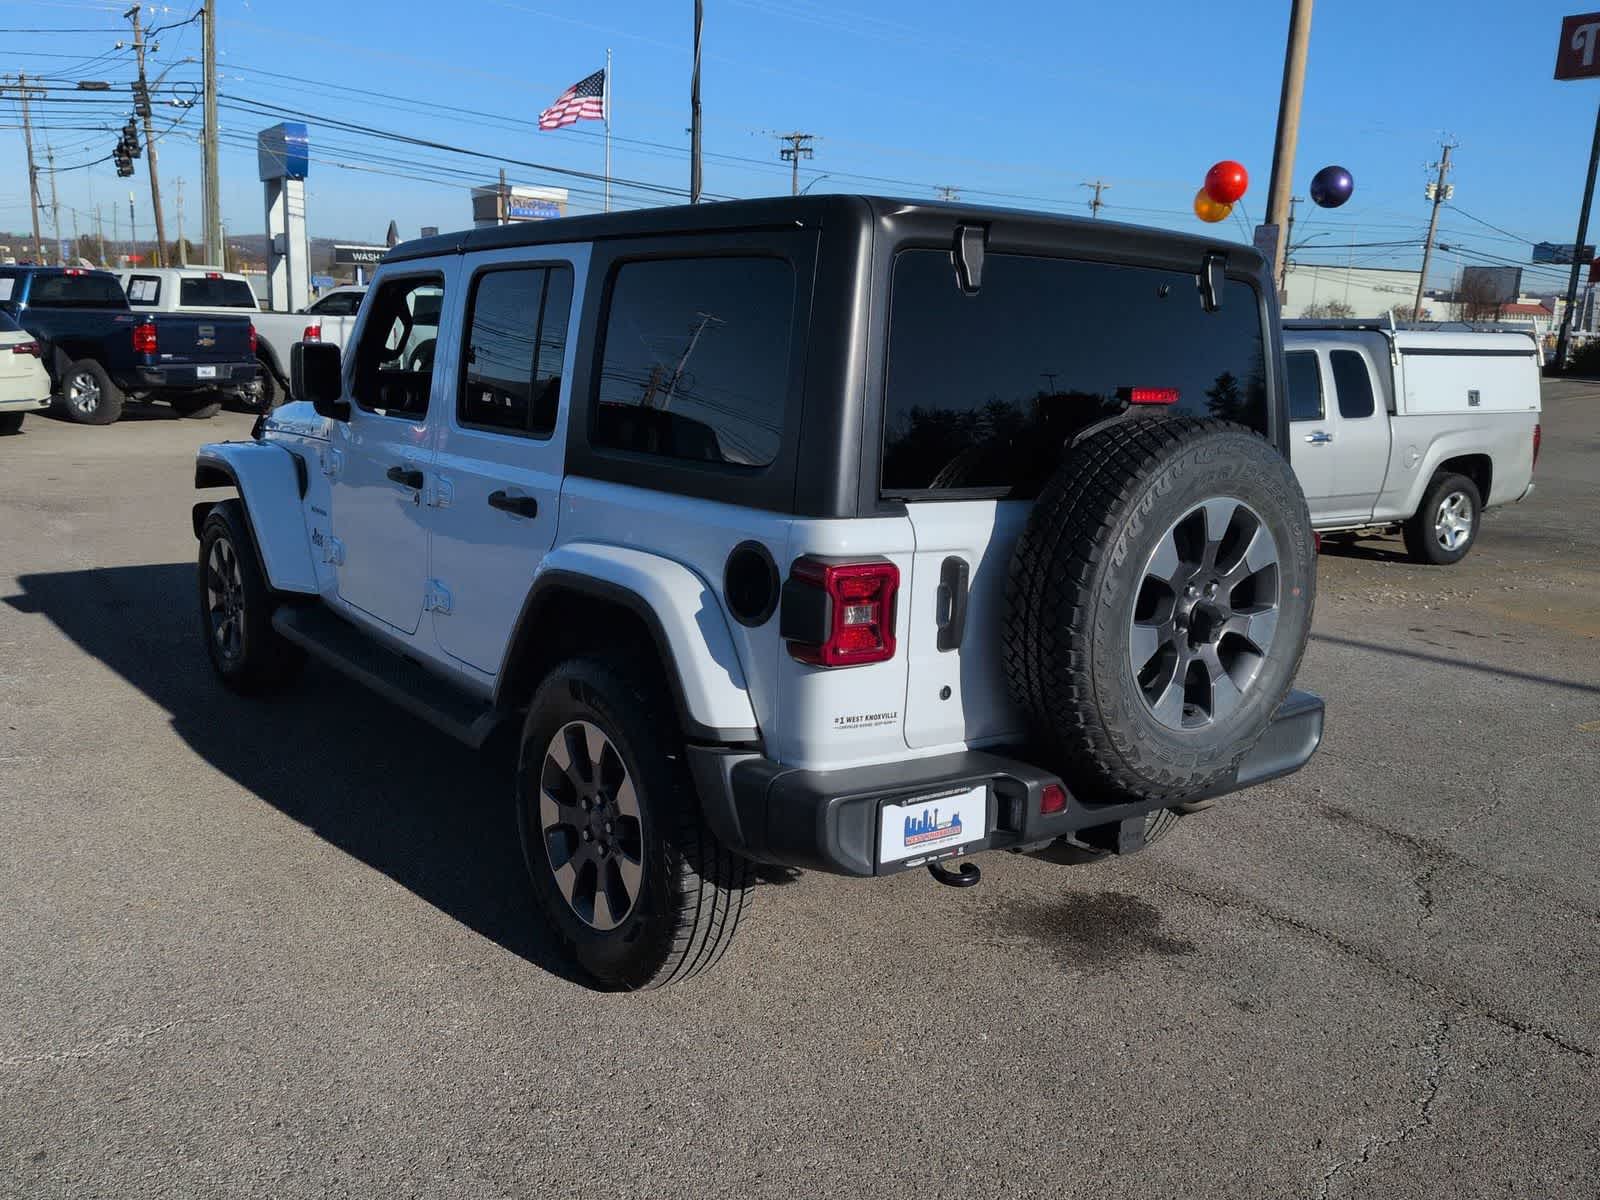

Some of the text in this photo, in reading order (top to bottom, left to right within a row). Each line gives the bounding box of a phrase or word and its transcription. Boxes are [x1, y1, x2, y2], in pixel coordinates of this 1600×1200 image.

[352, 252, 380, 261] WASH
[846, 715, 863, 723] WEST
[865, 711, 897, 721] KNOXVILLE
